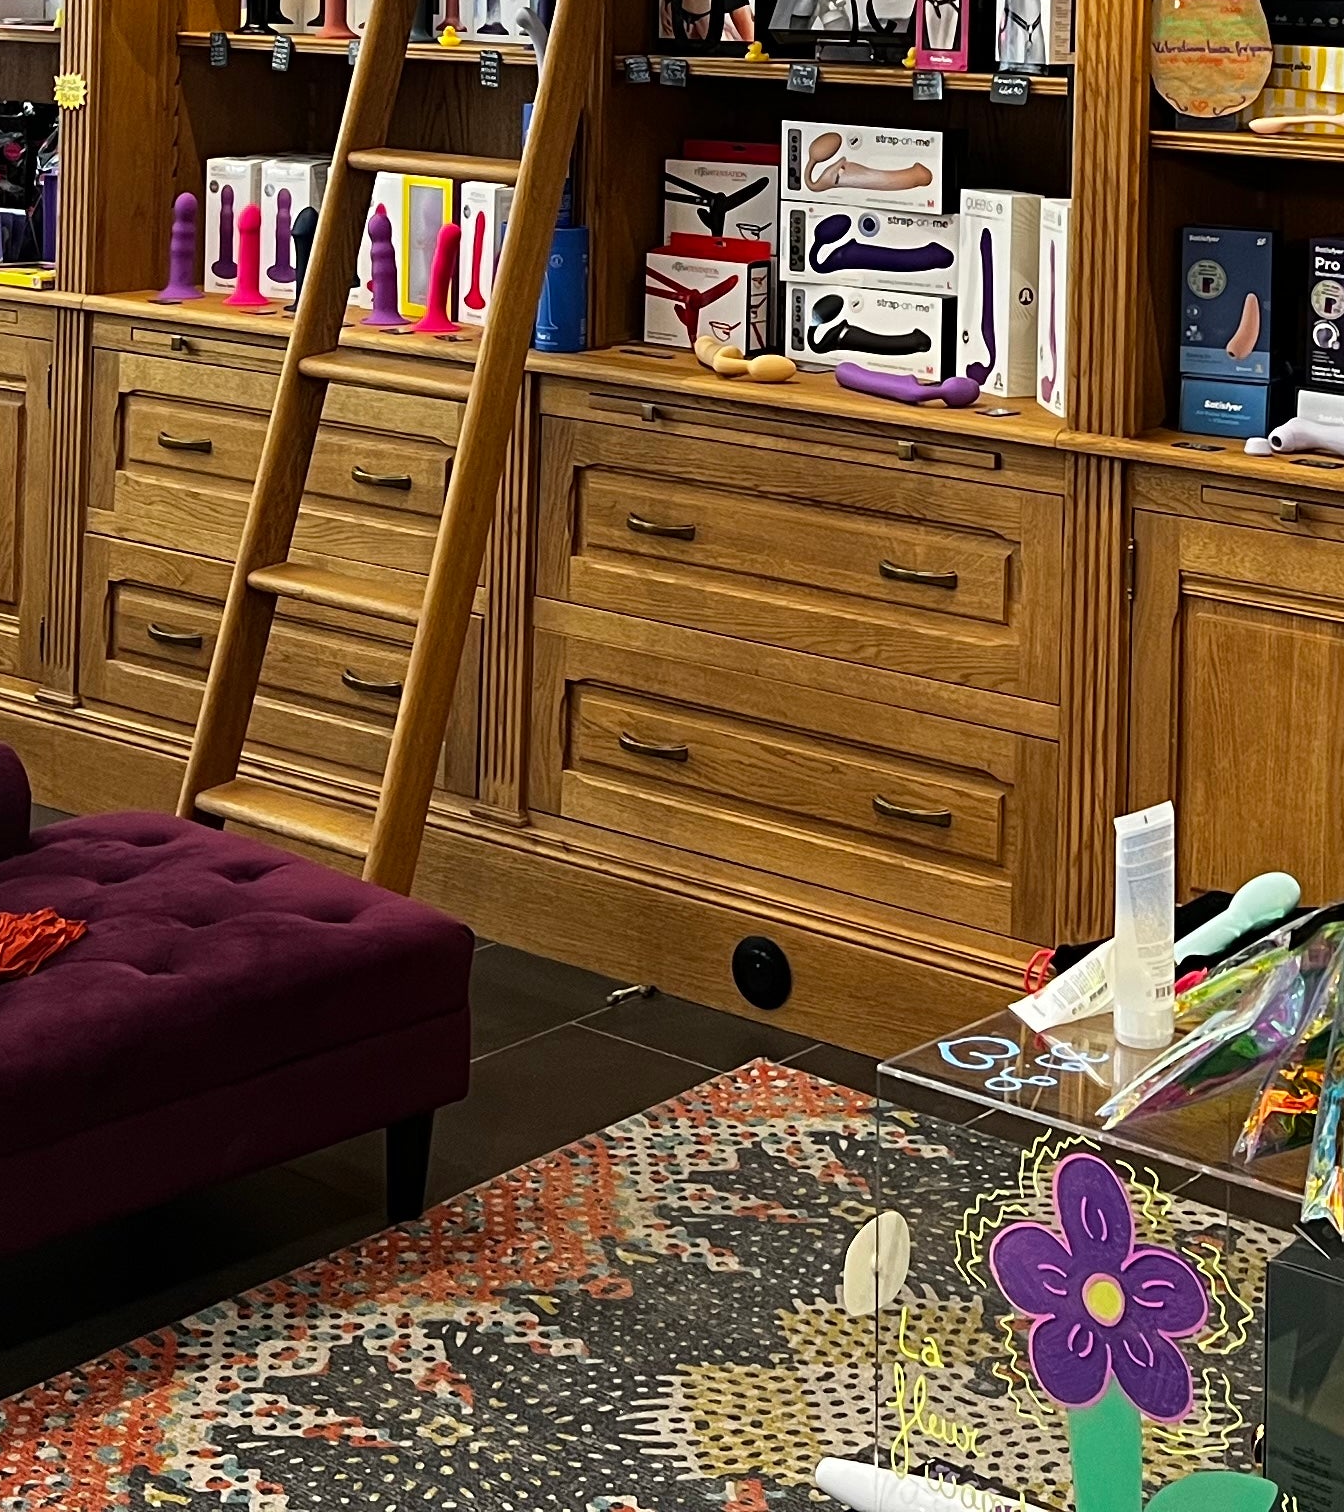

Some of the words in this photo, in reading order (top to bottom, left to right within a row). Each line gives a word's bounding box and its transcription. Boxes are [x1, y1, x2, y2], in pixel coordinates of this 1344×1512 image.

[927, 199, 935, 208] M
[1314, 256, 1340, 272] Pro
[1203, 398, 1243, 413] Satisfyer
[899, 1306, 945, 1369] La
[885, 1361, 986, 1480] fleur
